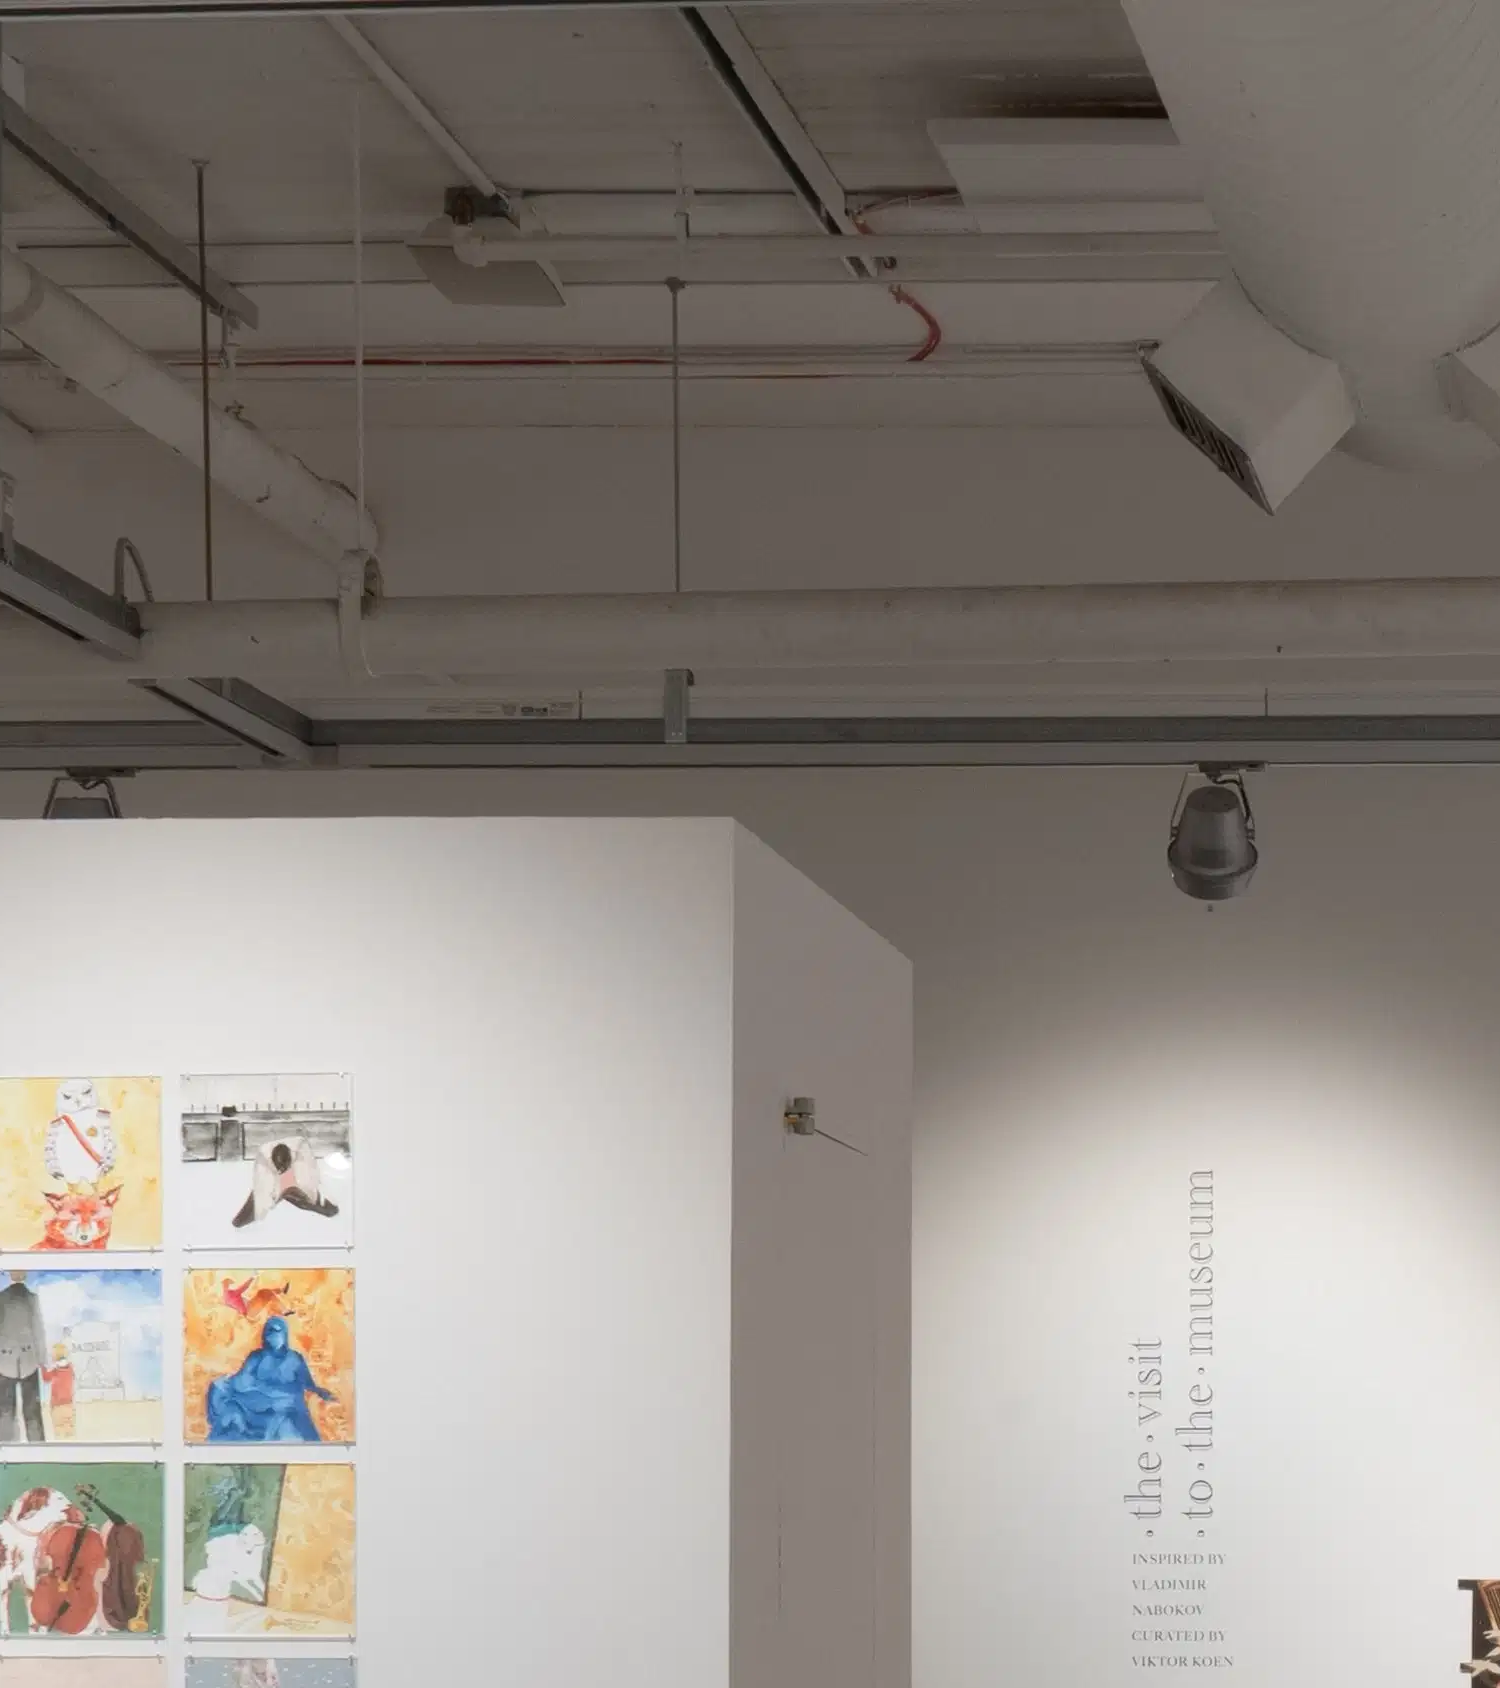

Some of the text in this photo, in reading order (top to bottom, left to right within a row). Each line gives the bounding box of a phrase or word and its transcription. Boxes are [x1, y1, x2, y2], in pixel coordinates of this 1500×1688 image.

[1175, 1169, 1214, 1520] to the museum
[1124, 1337, 1162, 1520] the visit
[1132, 1553, 1226, 1565] INSPIRED BY
[1132, 1579, 1207, 1591] VLADIMIR
[1132, 1604, 1204, 1616] NABOKOV
[1131, 1630, 1226, 1642] CURATED BY
[1132, 1656, 1234, 1668] VIKTOR KOEN
